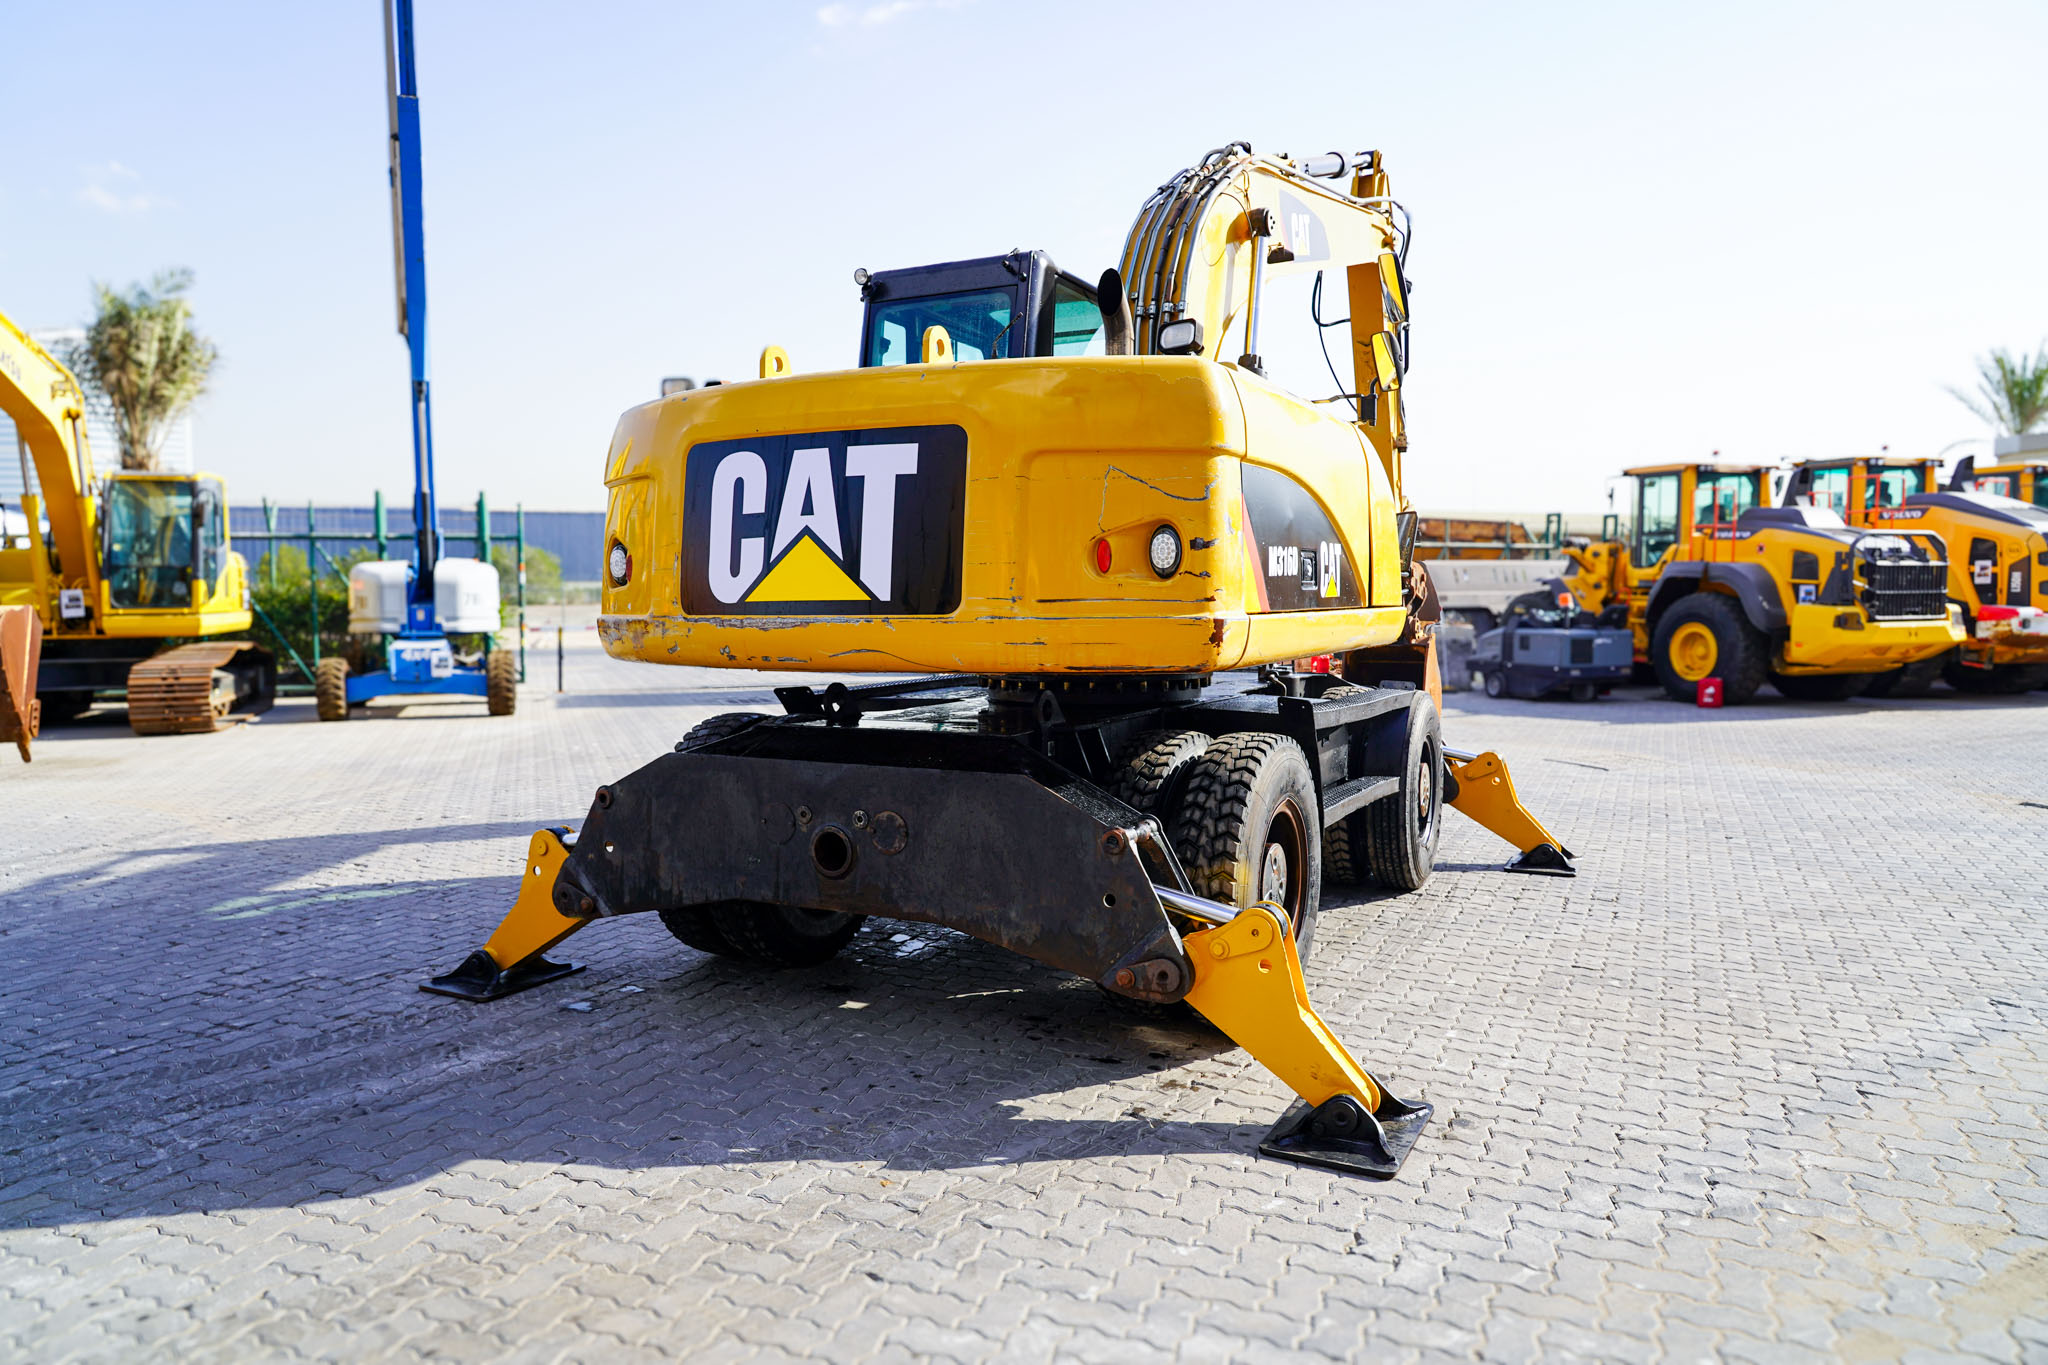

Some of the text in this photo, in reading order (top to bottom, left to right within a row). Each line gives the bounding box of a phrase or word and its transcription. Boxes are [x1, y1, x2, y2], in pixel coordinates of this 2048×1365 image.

[1291, 212, 1310, 255] CAT
[708, 443, 919, 604] CAT
[1268, 546, 1298, 577] M316D
[1320, 540, 1341, 598] CAT
